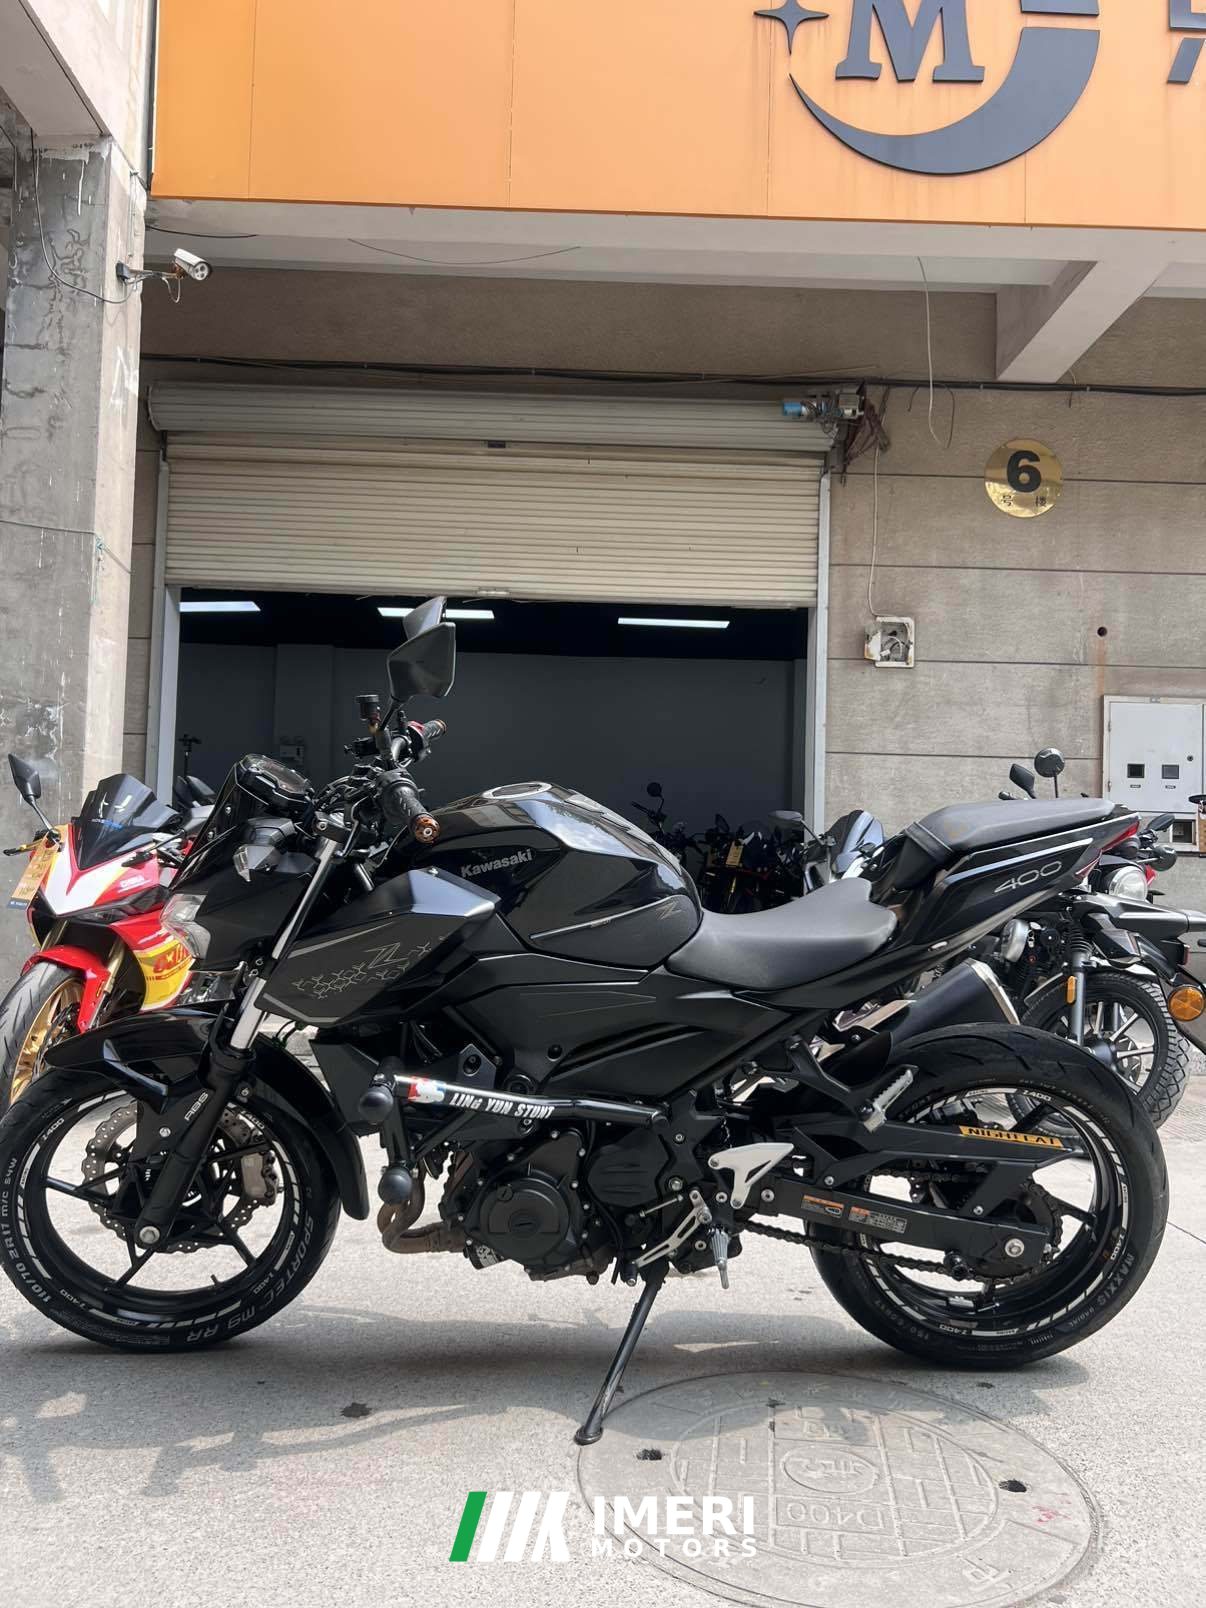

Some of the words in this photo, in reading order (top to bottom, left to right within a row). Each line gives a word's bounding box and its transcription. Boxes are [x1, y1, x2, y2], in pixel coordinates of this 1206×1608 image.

[1007, 450, 1042, 493] 6
[461, 848, 533, 878] Kawasaki
[994, 861, 1062, 893] 400
[184, 1091, 209, 1121] ABS
[485, 1098, 513, 1115] YUN
[514, 1103, 555, 1119] STUNT
[1097, 1253, 1135, 1305] MAXXIS
[786, 1501, 885, 1529] D400
